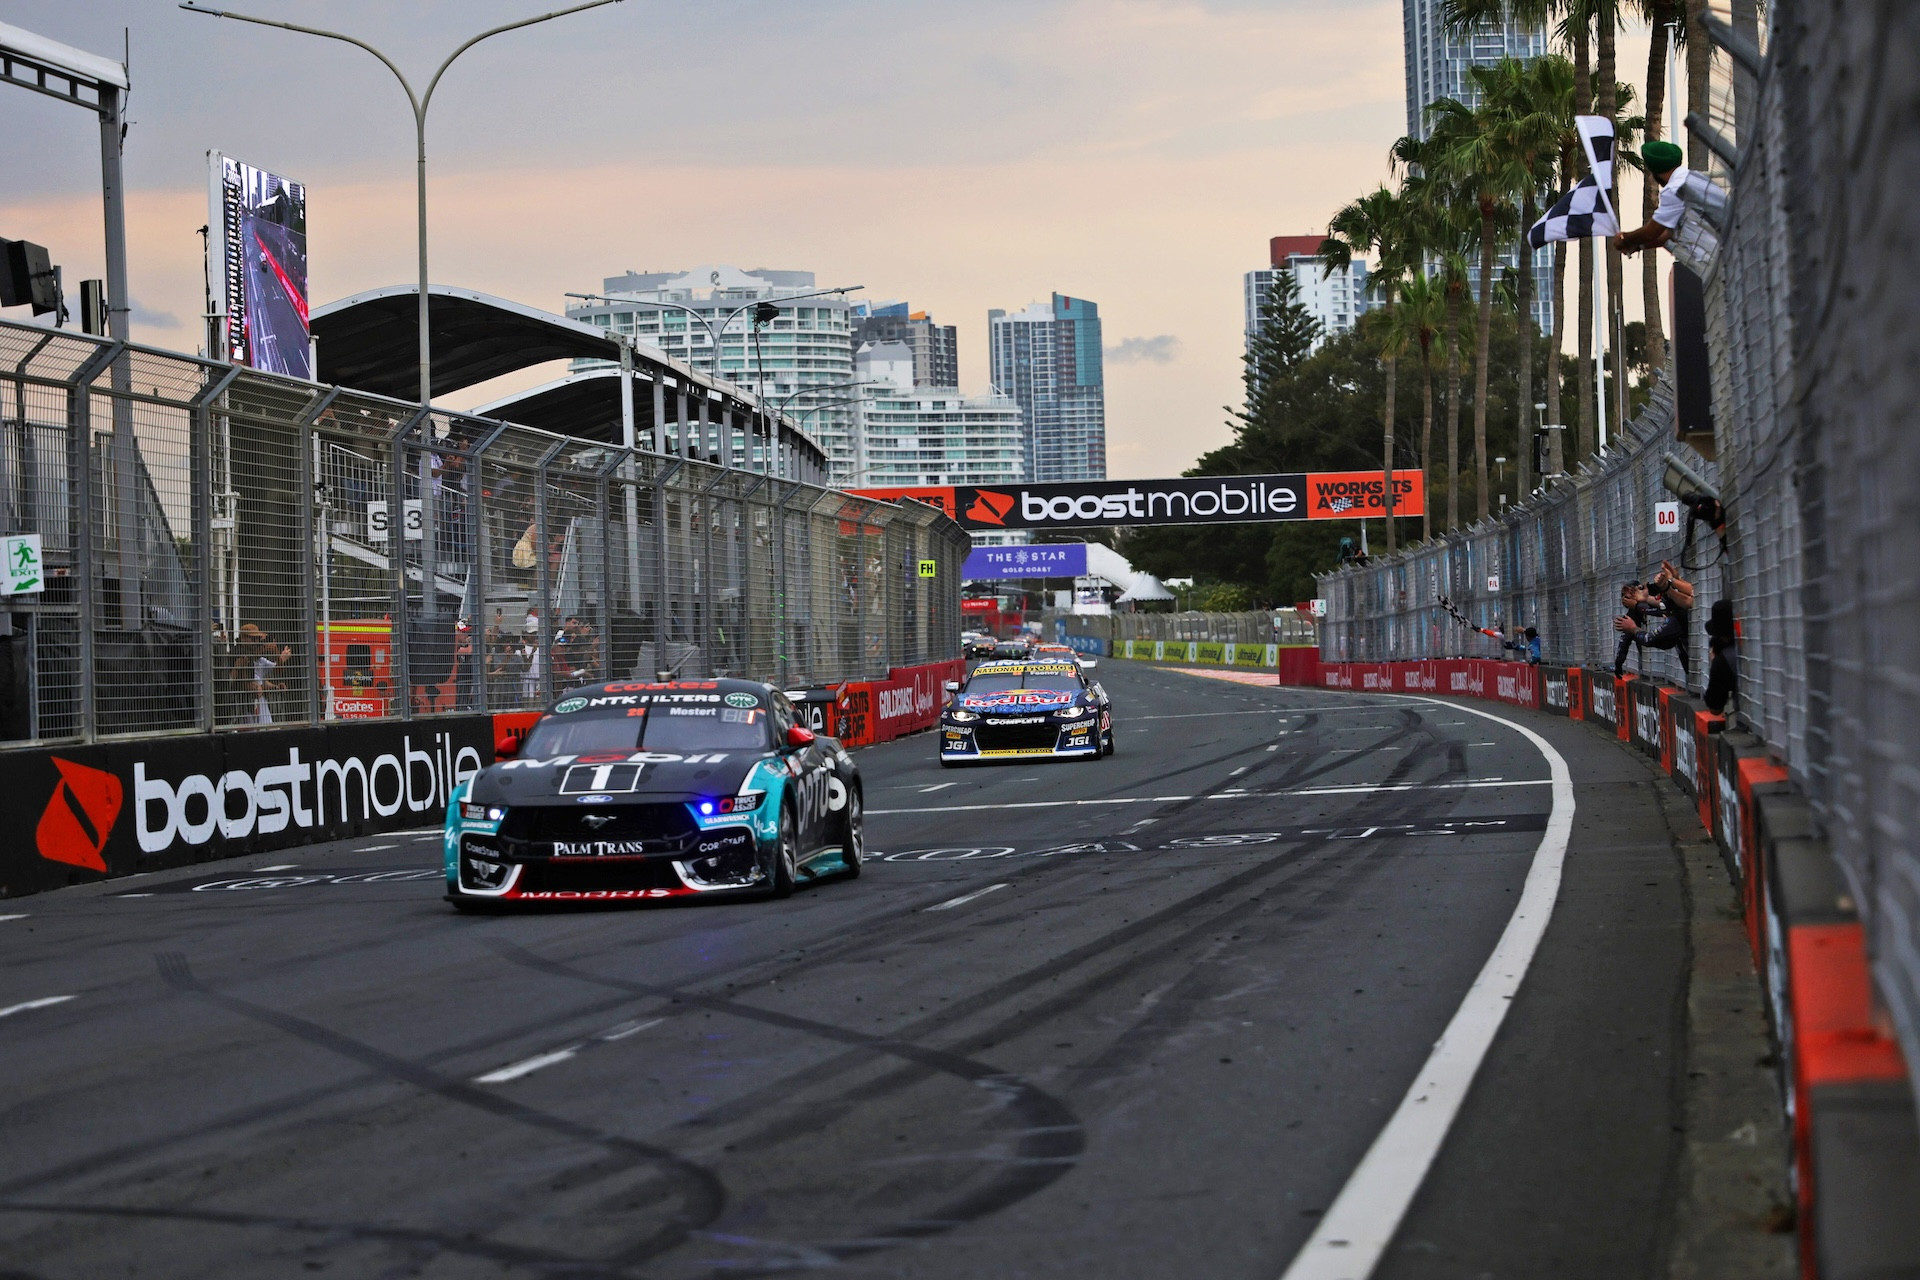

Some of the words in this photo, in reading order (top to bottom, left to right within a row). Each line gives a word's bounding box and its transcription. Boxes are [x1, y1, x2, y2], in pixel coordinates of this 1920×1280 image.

[1316, 480, 1383, 496] WORKS
[1021, 482, 1297, 521] boostmobile
[1316, 495, 1365, 510] AE
[1658, 511, 1675, 526] 0.0
[987, 553, 1012, 563] THE
[1031, 551, 1066, 562] STAR
[11, 569, 38, 577] EXIT
[920, 563, 934, 574] FH
[977, 667, 1021, 675] NATIONAL
[604, 681, 718, 693] Coates
[336, 700, 373, 712] Coates
[589, 695, 638, 706] NTK
[640, 694, 721, 705] FILTERS
[963, 695, 1017, 707] Red
[1018, 693, 1072, 705] Bull
[670, 708, 716, 716] Mostert
[502, 752, 729, 770] Mobil
[134, 732, 482, 853] boostmobile
[734, 796, 757, 805] TRUCK
[733, 802, 756, 812] ASSIST
[704, 814, 750, 825] GEARWRENCH
[553, 842, 592, 857] PALM
[594, 841, 643, 855] TRANS
